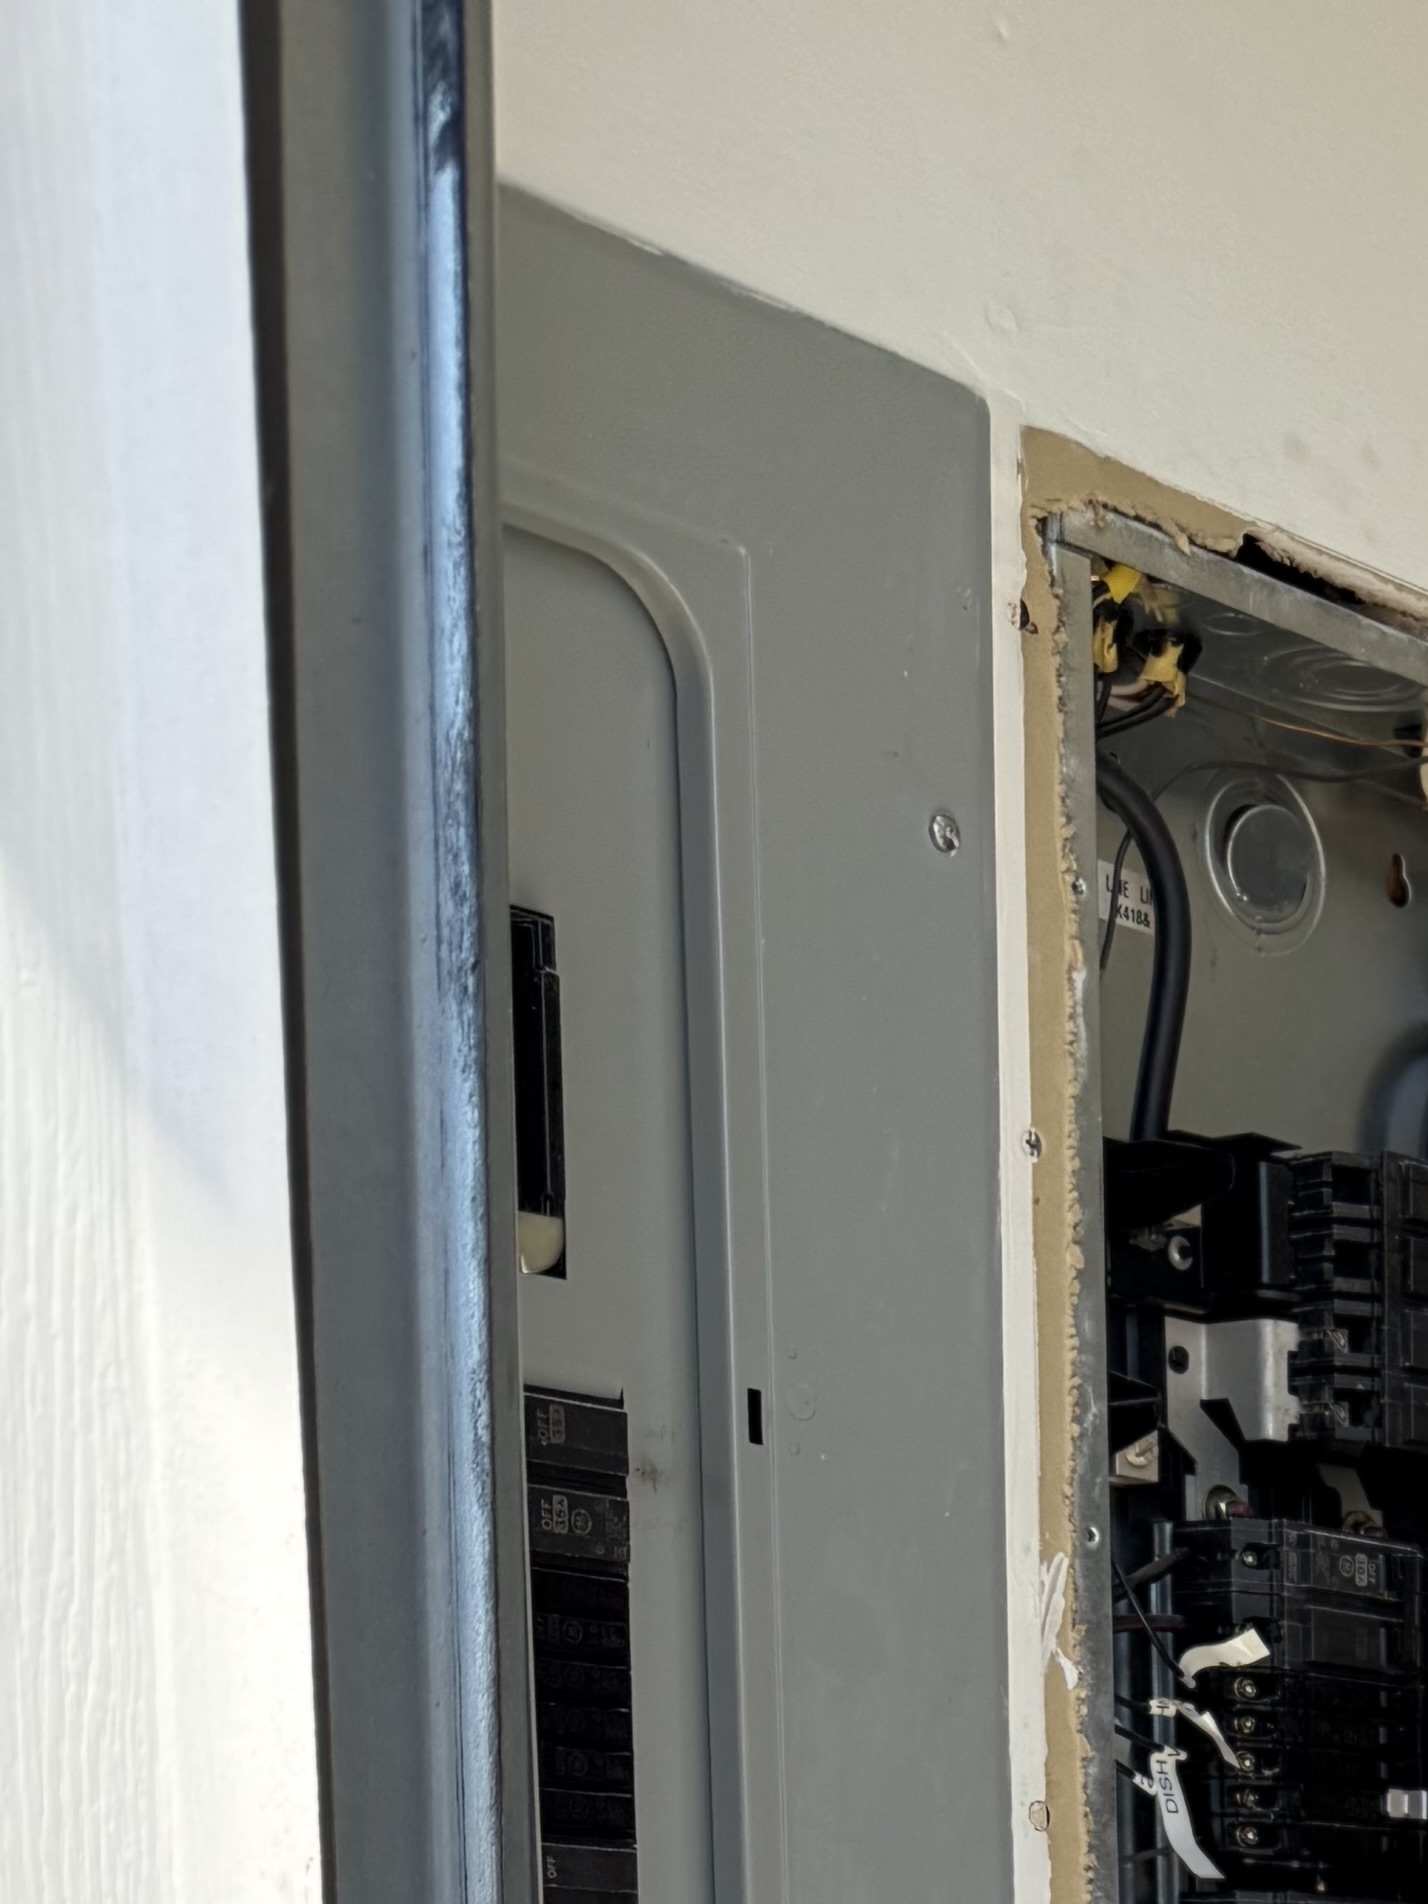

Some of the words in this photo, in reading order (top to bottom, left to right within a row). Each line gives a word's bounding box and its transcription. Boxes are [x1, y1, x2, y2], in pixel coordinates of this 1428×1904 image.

[537, 1408, 549, 1441] OFF
[541, 1499, 552, 1530] OFF
[546, 1855, 557, 1879] OFF
